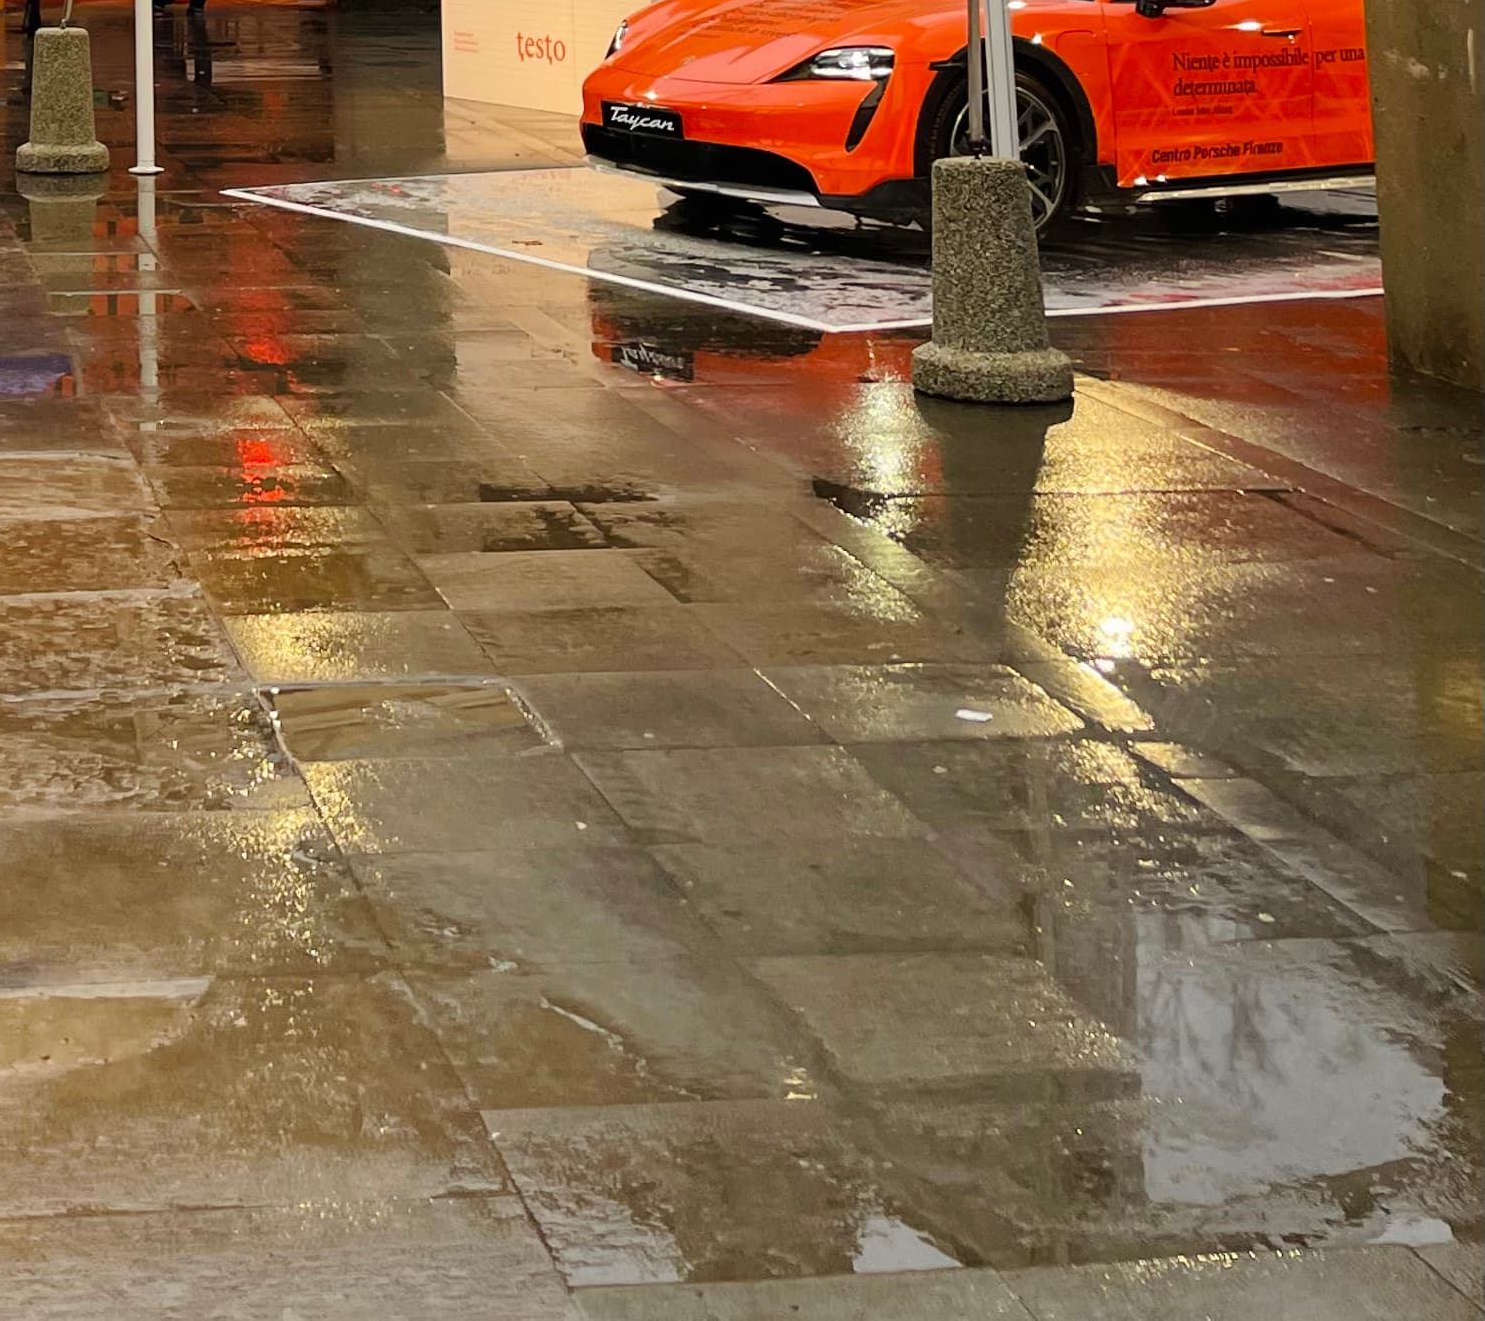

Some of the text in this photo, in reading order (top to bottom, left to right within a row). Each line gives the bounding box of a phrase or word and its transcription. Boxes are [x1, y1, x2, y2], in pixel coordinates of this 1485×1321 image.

[516, 31, 566, 65] testo
[1172, 46, 1365, 72] Niente è impossibile per una
[610, 105, 675, 131] Taycan
[1152, 140, 1284, 164] Centro Porsche Firenze
